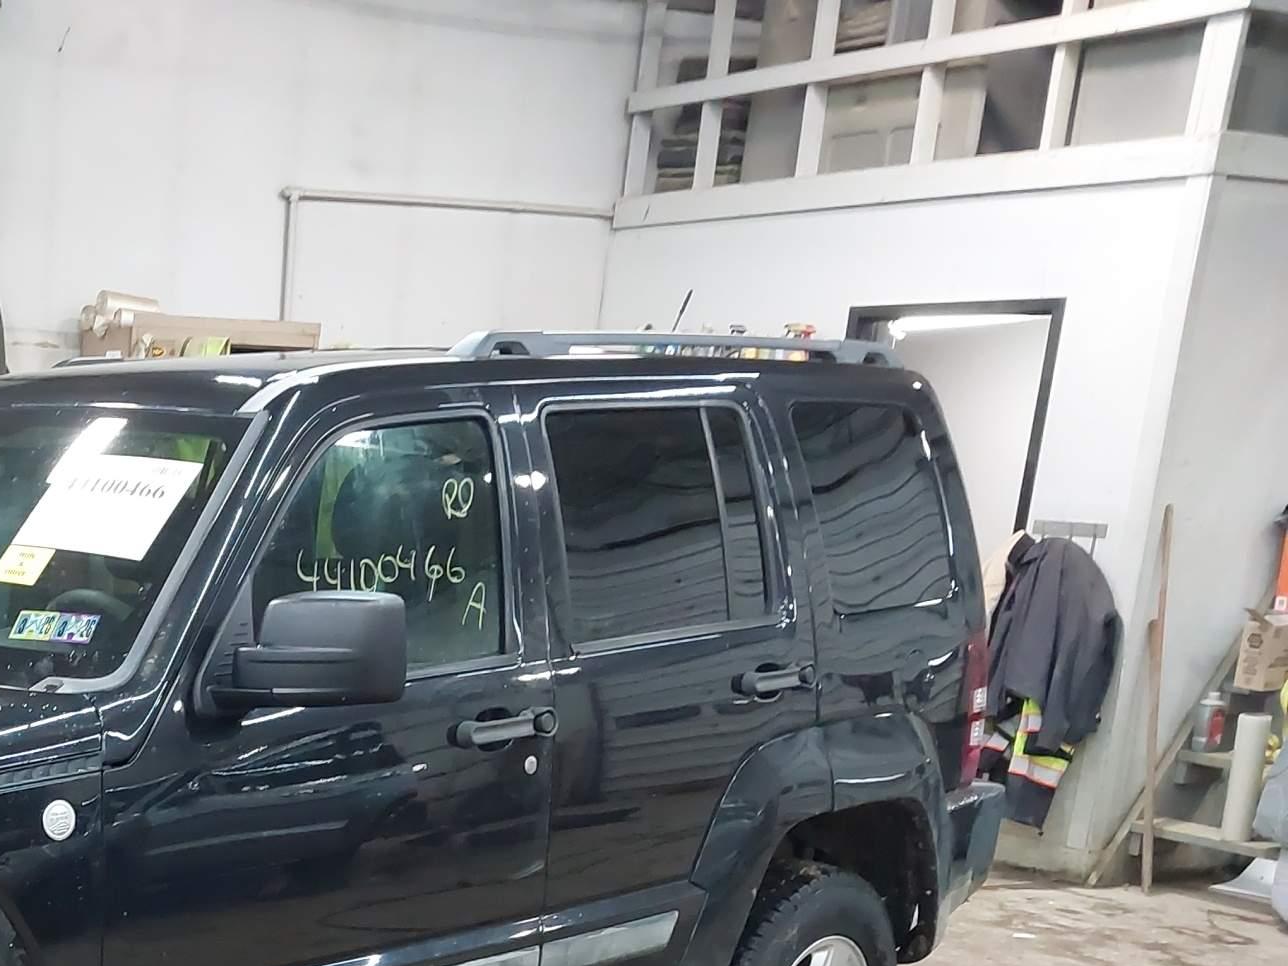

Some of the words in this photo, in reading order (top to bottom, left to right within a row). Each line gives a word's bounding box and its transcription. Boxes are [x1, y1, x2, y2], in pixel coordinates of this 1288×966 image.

[69, 477, 166, 499] 100466
[296, 544, 465, 602] 44100466
[462, 582, 486, 630] A
